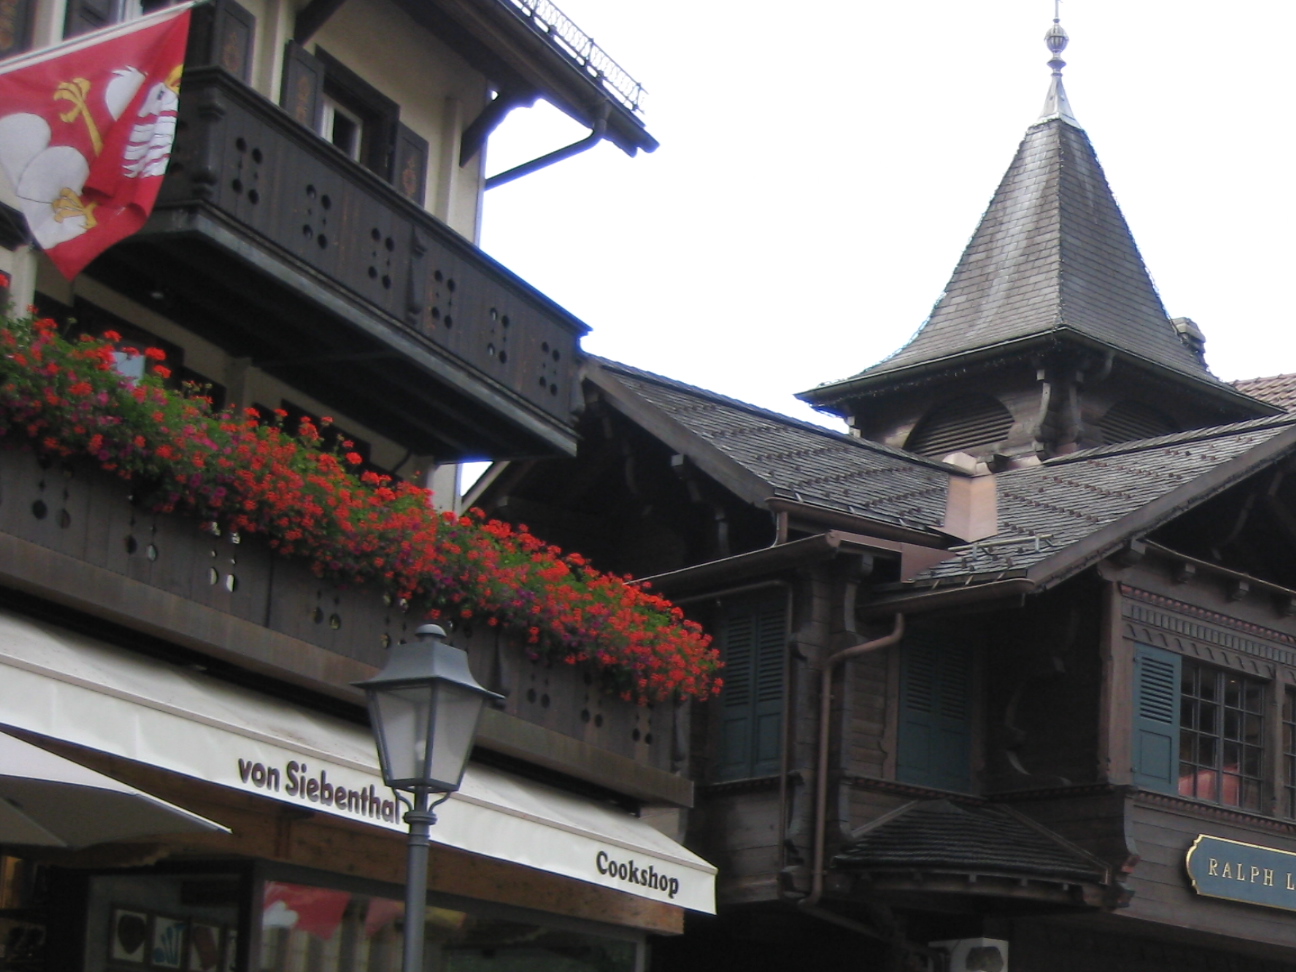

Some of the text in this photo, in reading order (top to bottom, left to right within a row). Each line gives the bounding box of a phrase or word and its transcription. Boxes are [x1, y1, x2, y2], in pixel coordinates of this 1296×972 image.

[237, 757, 401, 825] von Siebenthal
[595, 850, 679, 899] Cookshop
[1208, 857, 1275, 887] RALPH
